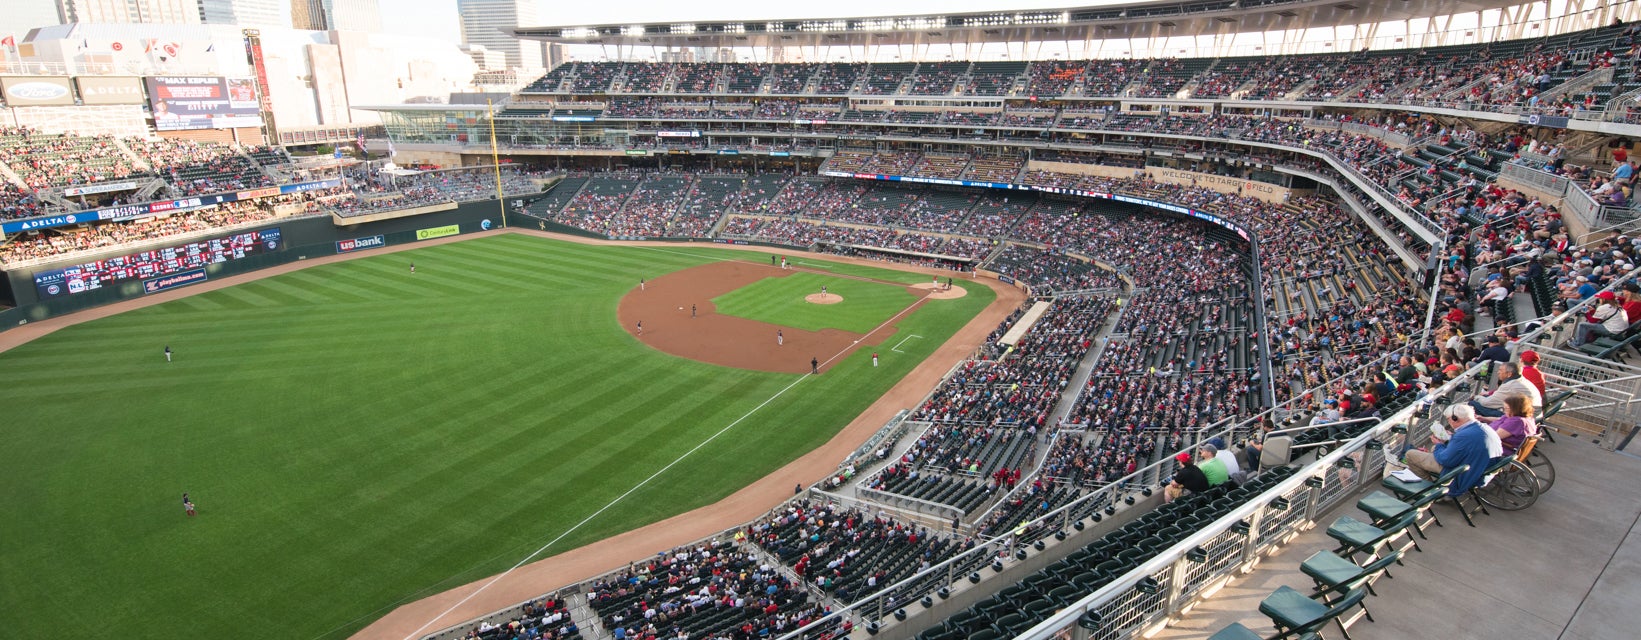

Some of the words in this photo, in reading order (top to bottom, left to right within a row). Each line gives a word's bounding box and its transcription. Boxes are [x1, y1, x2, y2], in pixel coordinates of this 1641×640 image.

[21, 86, 56, 96] Ford
[98, 86, 140, 94] DELTA
[1162, 170, 1204, 181] WELCOME
[1216, 178, 1246, 188] TARGET
[1252, 184, 1274, 194] FIELD
[85, 184, 131, 193] SUPERAMERICA
[32, 218, 63, 227] DELTA
